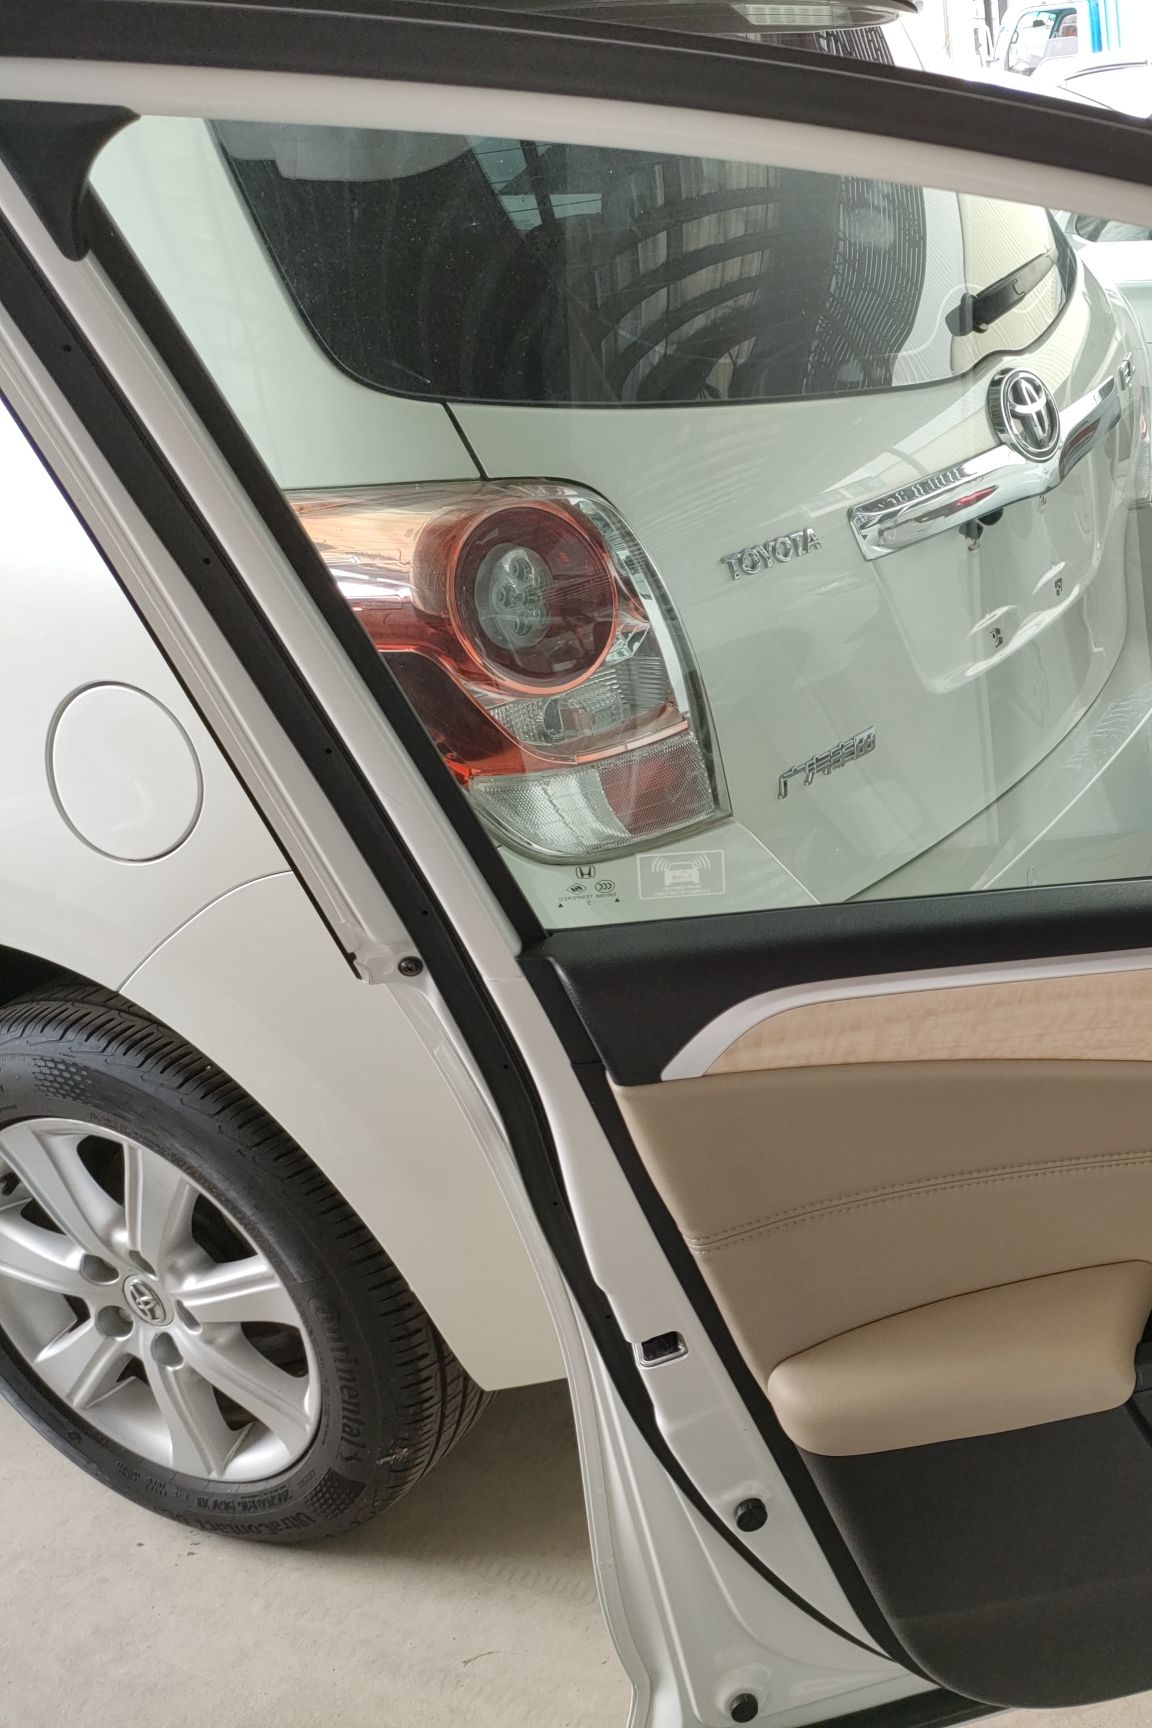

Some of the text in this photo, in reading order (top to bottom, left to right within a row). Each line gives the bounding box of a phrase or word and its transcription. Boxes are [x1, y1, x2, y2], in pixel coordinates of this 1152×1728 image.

[720, 527, 823, 580] TOYOTA
[777, 725, 876, 799] 广汽丰田
[308, 1298, 367, 1450] Continental
